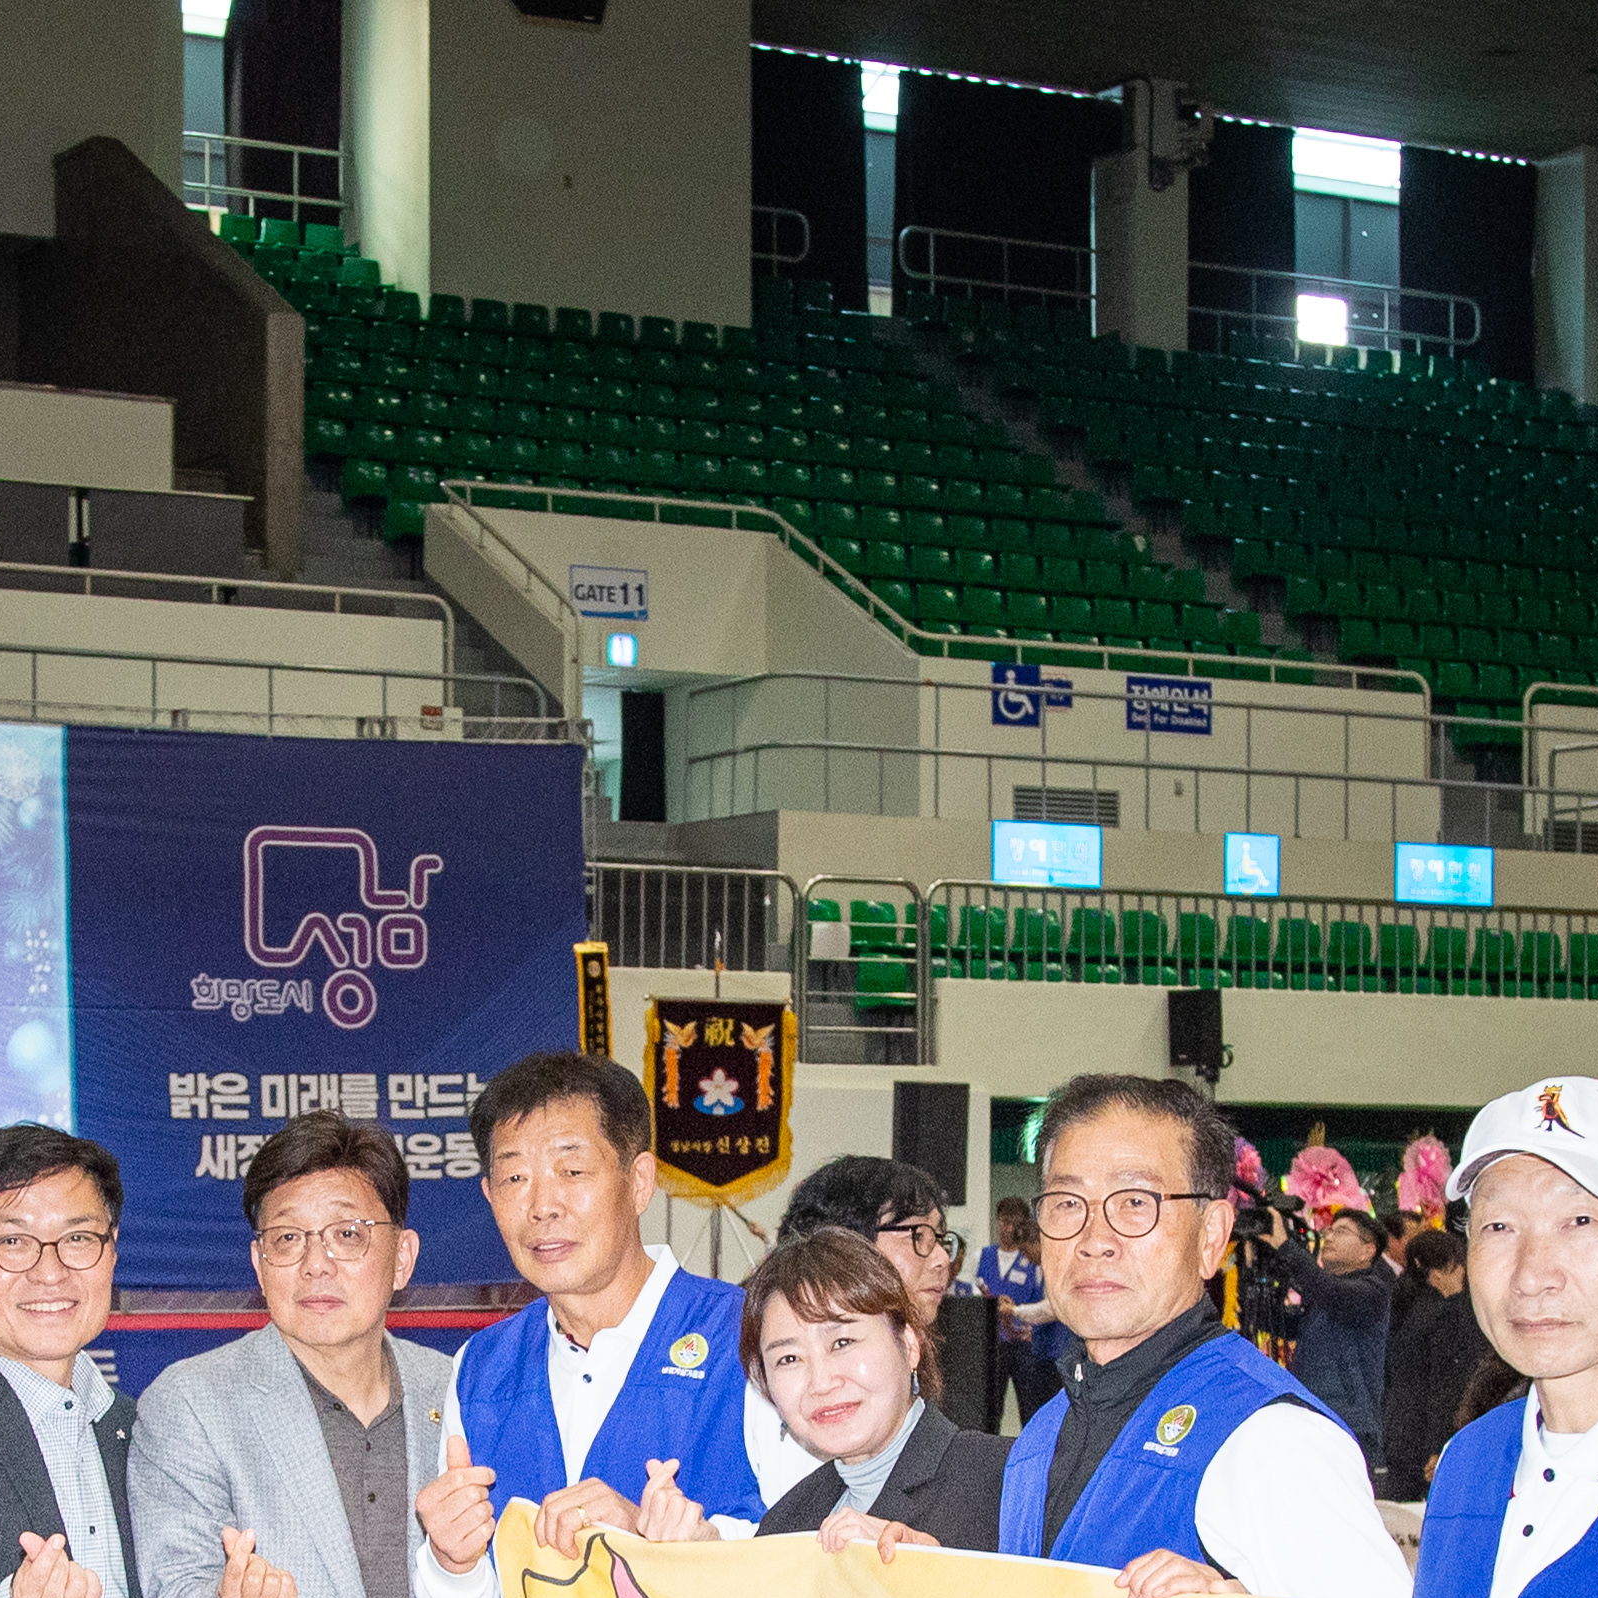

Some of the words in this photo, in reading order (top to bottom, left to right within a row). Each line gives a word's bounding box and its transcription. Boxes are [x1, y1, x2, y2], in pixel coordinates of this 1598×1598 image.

[574, 583, 616, 603] GATE
[620, 582, 644, 606] 11
[190, 973, 314, 1022] 희망도시
[705, 1017, 735, 1047] 祝
[168, 1072, 251, 1120] 밝은
[260, 1073, 380, 1119] 미래를
[716, 1136, 771, 1155] 신상진
